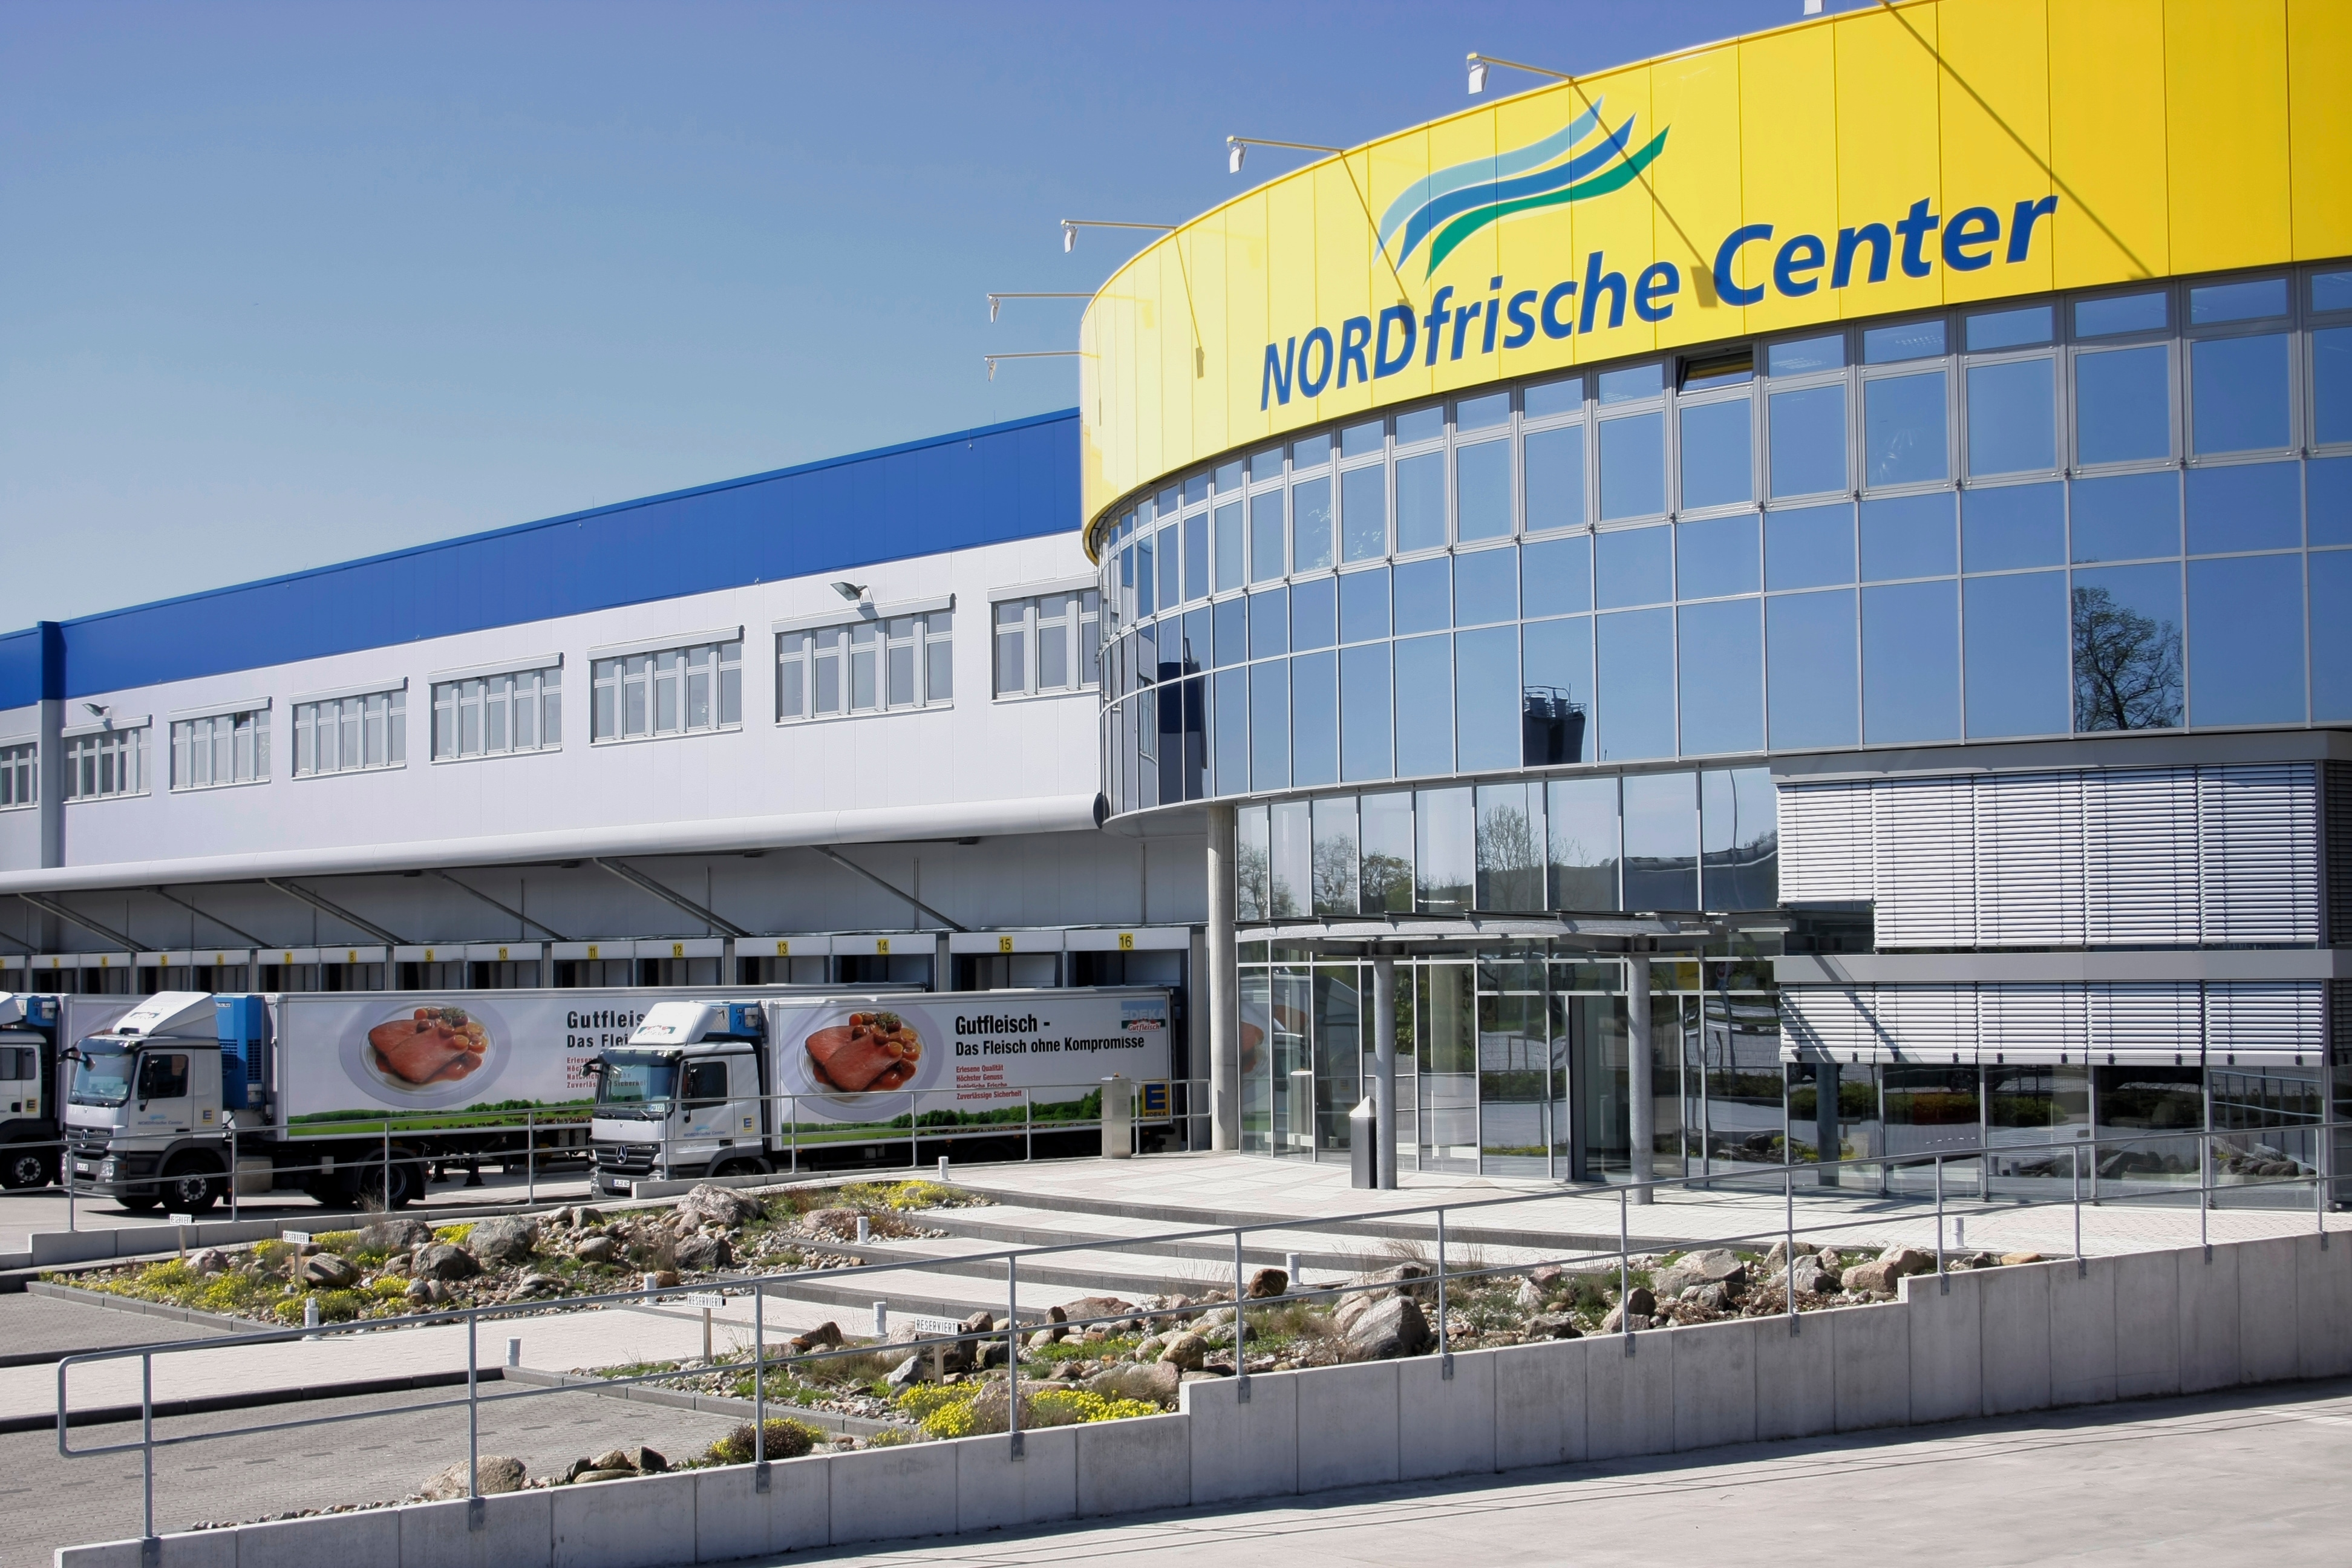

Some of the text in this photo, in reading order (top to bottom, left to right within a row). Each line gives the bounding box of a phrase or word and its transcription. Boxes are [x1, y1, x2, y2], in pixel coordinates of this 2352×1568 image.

[1261, 196, 2058, 411] NORDfrische Center
[877, 941, 887, 952] 14
[1000, 938, 1011, 950] 15
[1120, 935, 1132, 948] 16
[498, 949, 507, 959] 10
[589, 948, 596, 958] 11
[673, 946, 682, 956] 12
[777, 944, 786, 954] 13
[286, 954, 290, 963] 7
[349, 953, 354, 962] 8
[426, 951, 431, 960] 9
[567, 1010, 645, 1029] Gutfleis
[1123, 1008, 1165, 1020] EDEKA
[955, 1013, 1037, 1035] Gutfleisch
[1128, 1023, 1160, 1033] Gutfleisch
[567, 1033, 629, 1048] Das Flei
[956, 1036, 1145, 1056] Das Fleisch ohne Kompromisse
[688, 1295, 720, 1307] RESERVIERT
[916, 1319, 955, 1334] RESERVIERT
